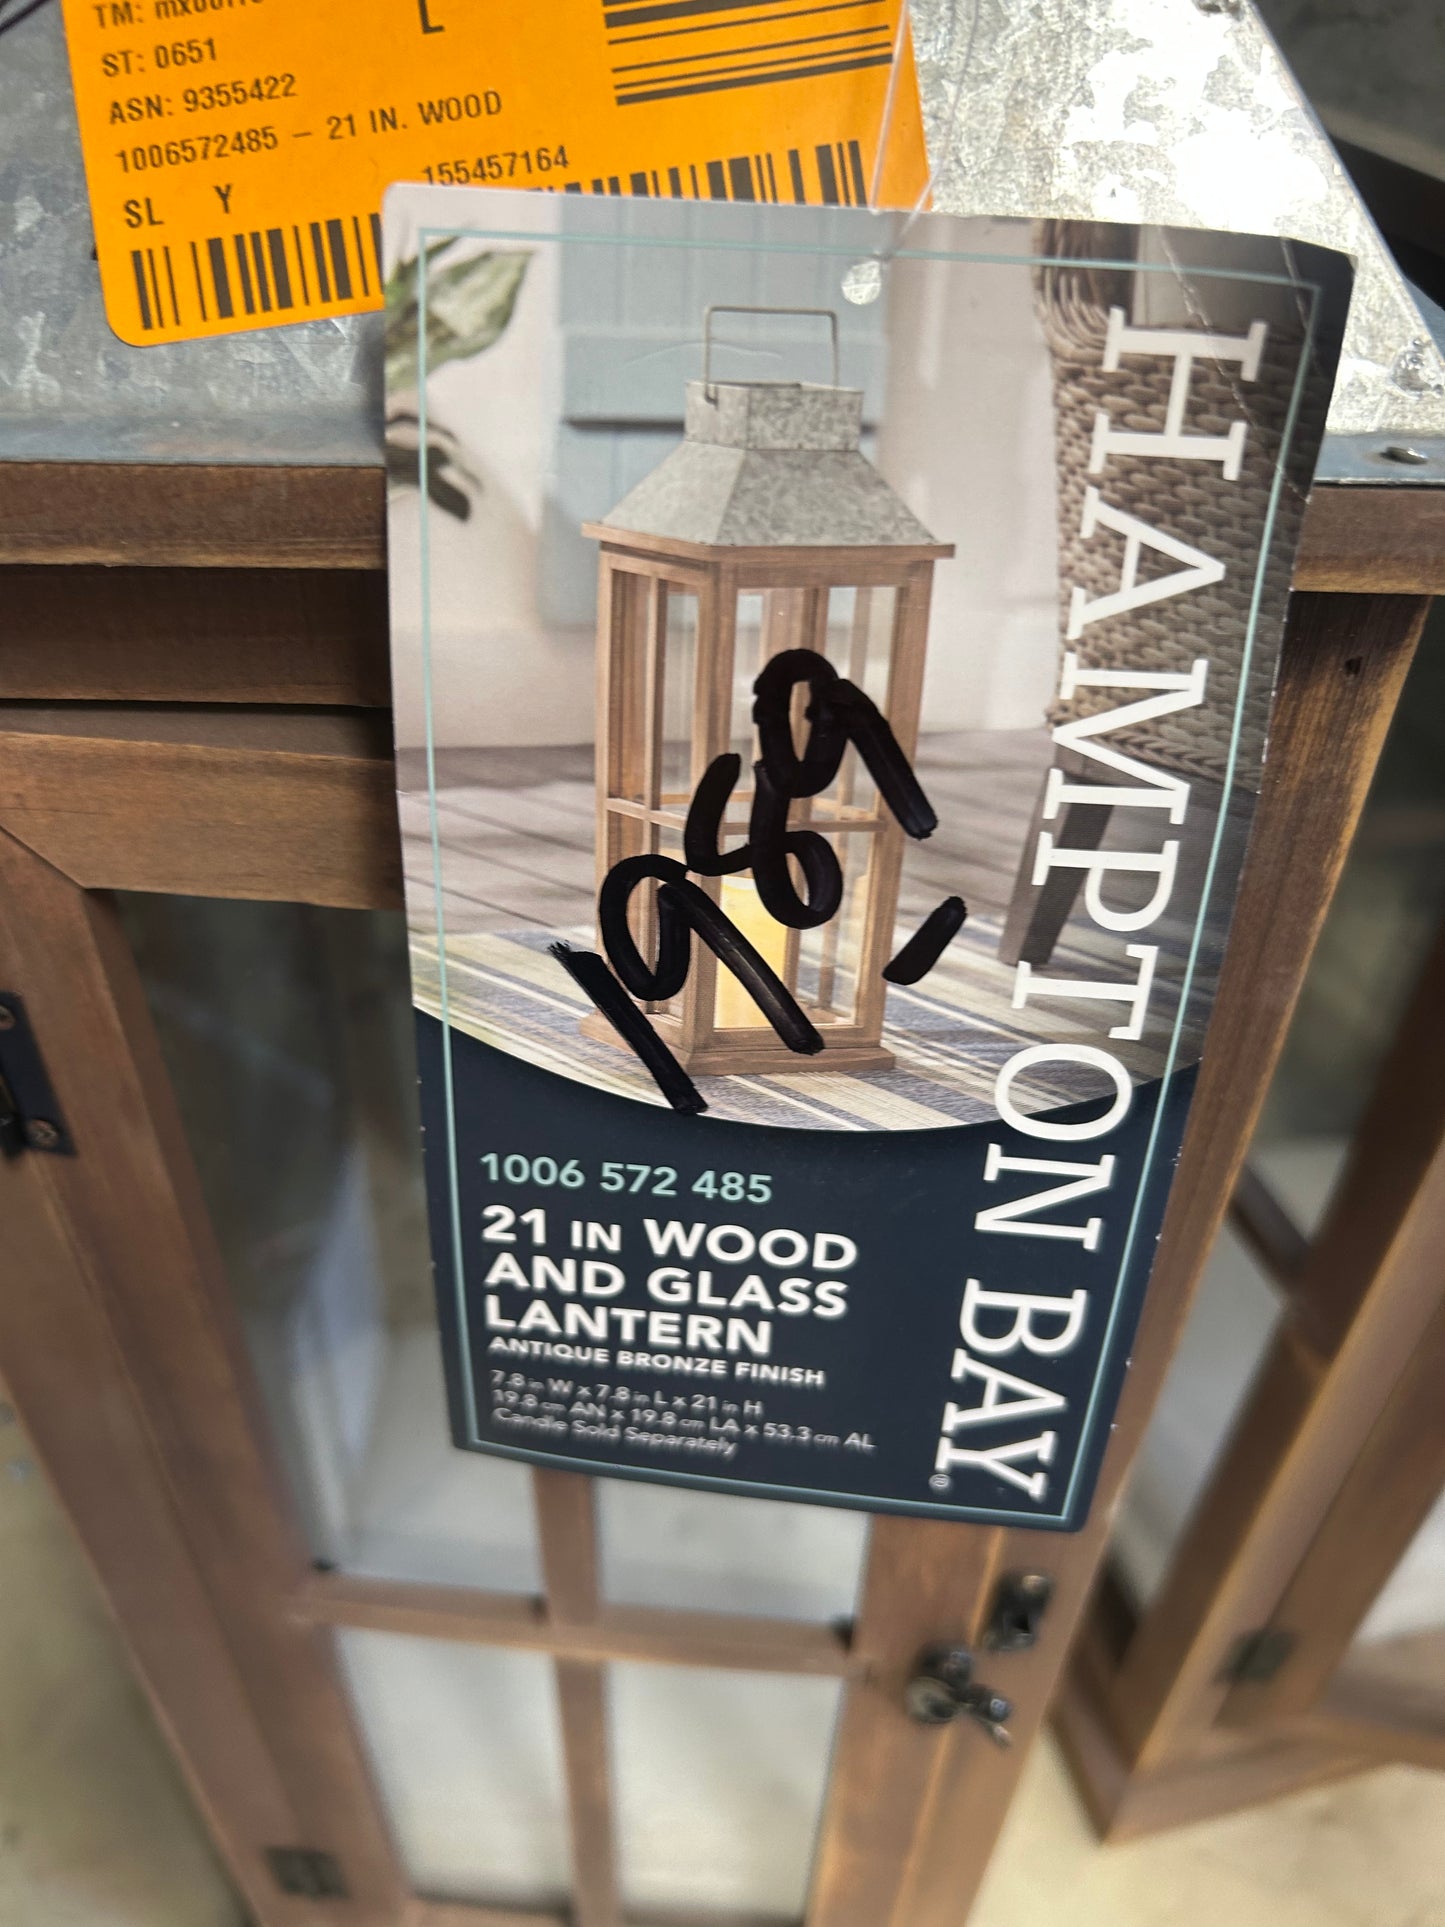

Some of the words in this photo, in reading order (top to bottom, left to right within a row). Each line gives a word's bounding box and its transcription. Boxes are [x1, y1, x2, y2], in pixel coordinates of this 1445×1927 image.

[92, 1, 145, 29] TM:
[101, 50, 146, 77] ST:
[154, 37, 217, 69] 0651
[109, 94, 174, 125] ASN:
[183, 73, 298, 113] 9355422
[115, 126, 278, 173] 1006572485
[327, 113, 356, 139] 21
[370, 107, 408, 134] IN.
[418, 90, 502, 125] WOOD
[422, 144, 570, 186] 155457164
[124, 197, 165, 229] SL
[213, 183, 232, 214] Y
[973, 305, 1267, 1252] HAMPTON
[480, 1152, 586, 1188] 1006
[600, 1161, 679, 1196] 572
[692, 1169, 773, 1204] 485
[481, 1204, 547, 1245] 21
[570, 1220, 622, 1253] IN
[643, 1217, 858, 1271] WOOD
[484, 1252, 626, 1298] AND
[647, 1266, 849, 1319] GLASS
[484, 1294, 773, 1356] LANTERN
[488, 1335, 611, 1366] ANTIQUE
[616, 1350, 728, 1377] BRONZE
[735, 1361, 826, 1388] FINISH
[547, 1377, 574, 1396] W
[691, 1393, 718, 1413] 21
[743, 1399, 764, 1418] H
[492, 1407, 569, 1434] Candle
[570, 1419, 622, 1443] Sold
[623, 1426, 739, 1461] Separately
[569, 1401, 608, 1421] AN
[709, 1416, 742, 1436] LA
[763, 1422, 814, 1445] 53.3
[843, 1431, 878, 1453] AL
